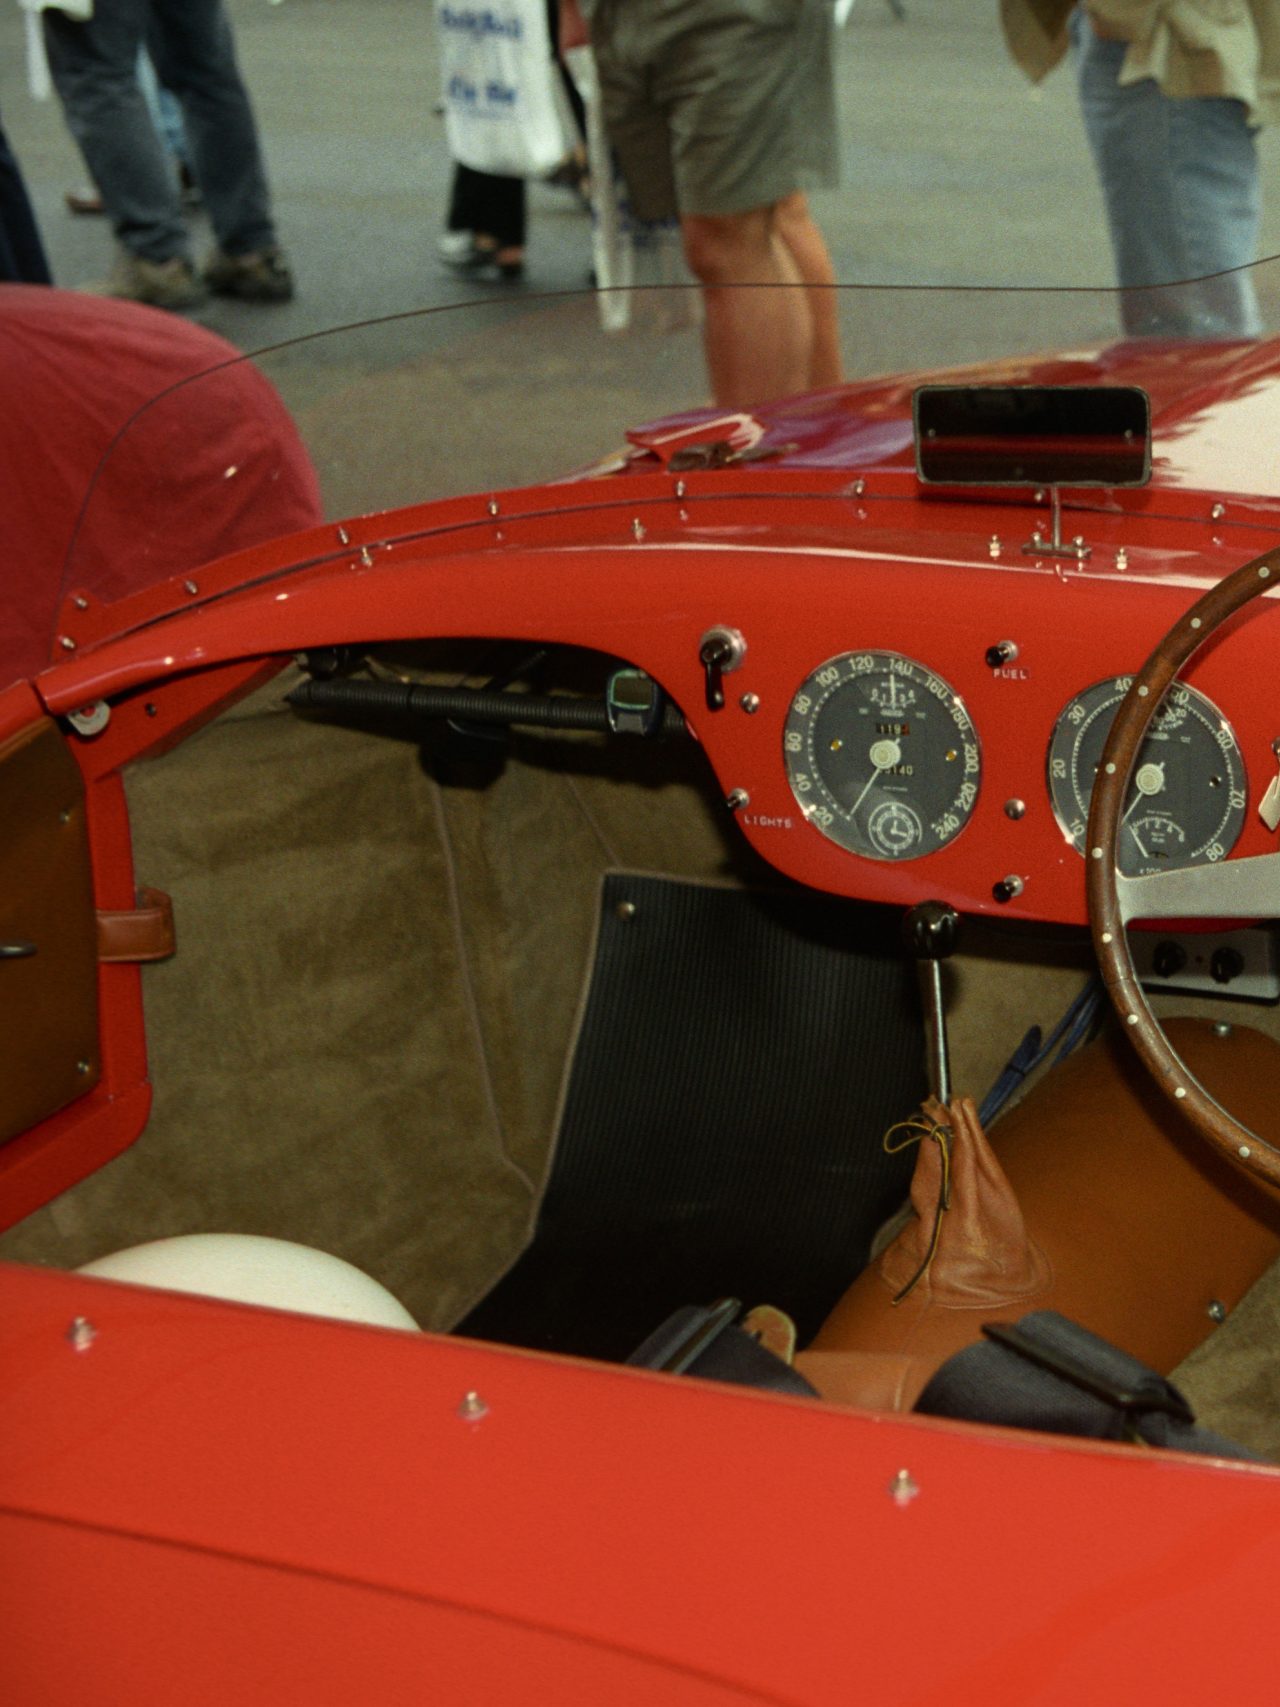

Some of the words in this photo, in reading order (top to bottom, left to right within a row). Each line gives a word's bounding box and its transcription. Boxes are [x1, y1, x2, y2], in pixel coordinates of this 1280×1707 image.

[849, 656, 874, 671] 120
[889, 659, 913, 676] 140
[815, 667, 840, 687] 100
[993, 668, 1027, 680] FUEL
[925, 676, 948, 700] 160
[1114, 678, 1132, 692] 40
[794, 695, 811, 715] 80
[1068, 705, 1085, 725] 30
[950, 706, 970, 731] 180
[786, 732, 802, 751] 60
[1217, 729, 1233, 750] 60
[963, 743, 979, 772] 200
[1053, 759, 1066, 778] 20
[795, 773, 811, 791] 40
[958, 782, 977, 811] 220
[1231, 790, 1245, 809] 70
[744, 815, 792, 829] LIGHTS
[814, 806, 834, 826] 20
[935, 815, 960, 840] 240
[1070, 817, 1085, 837] 10
[1205, 843, 1224, 861] 80
